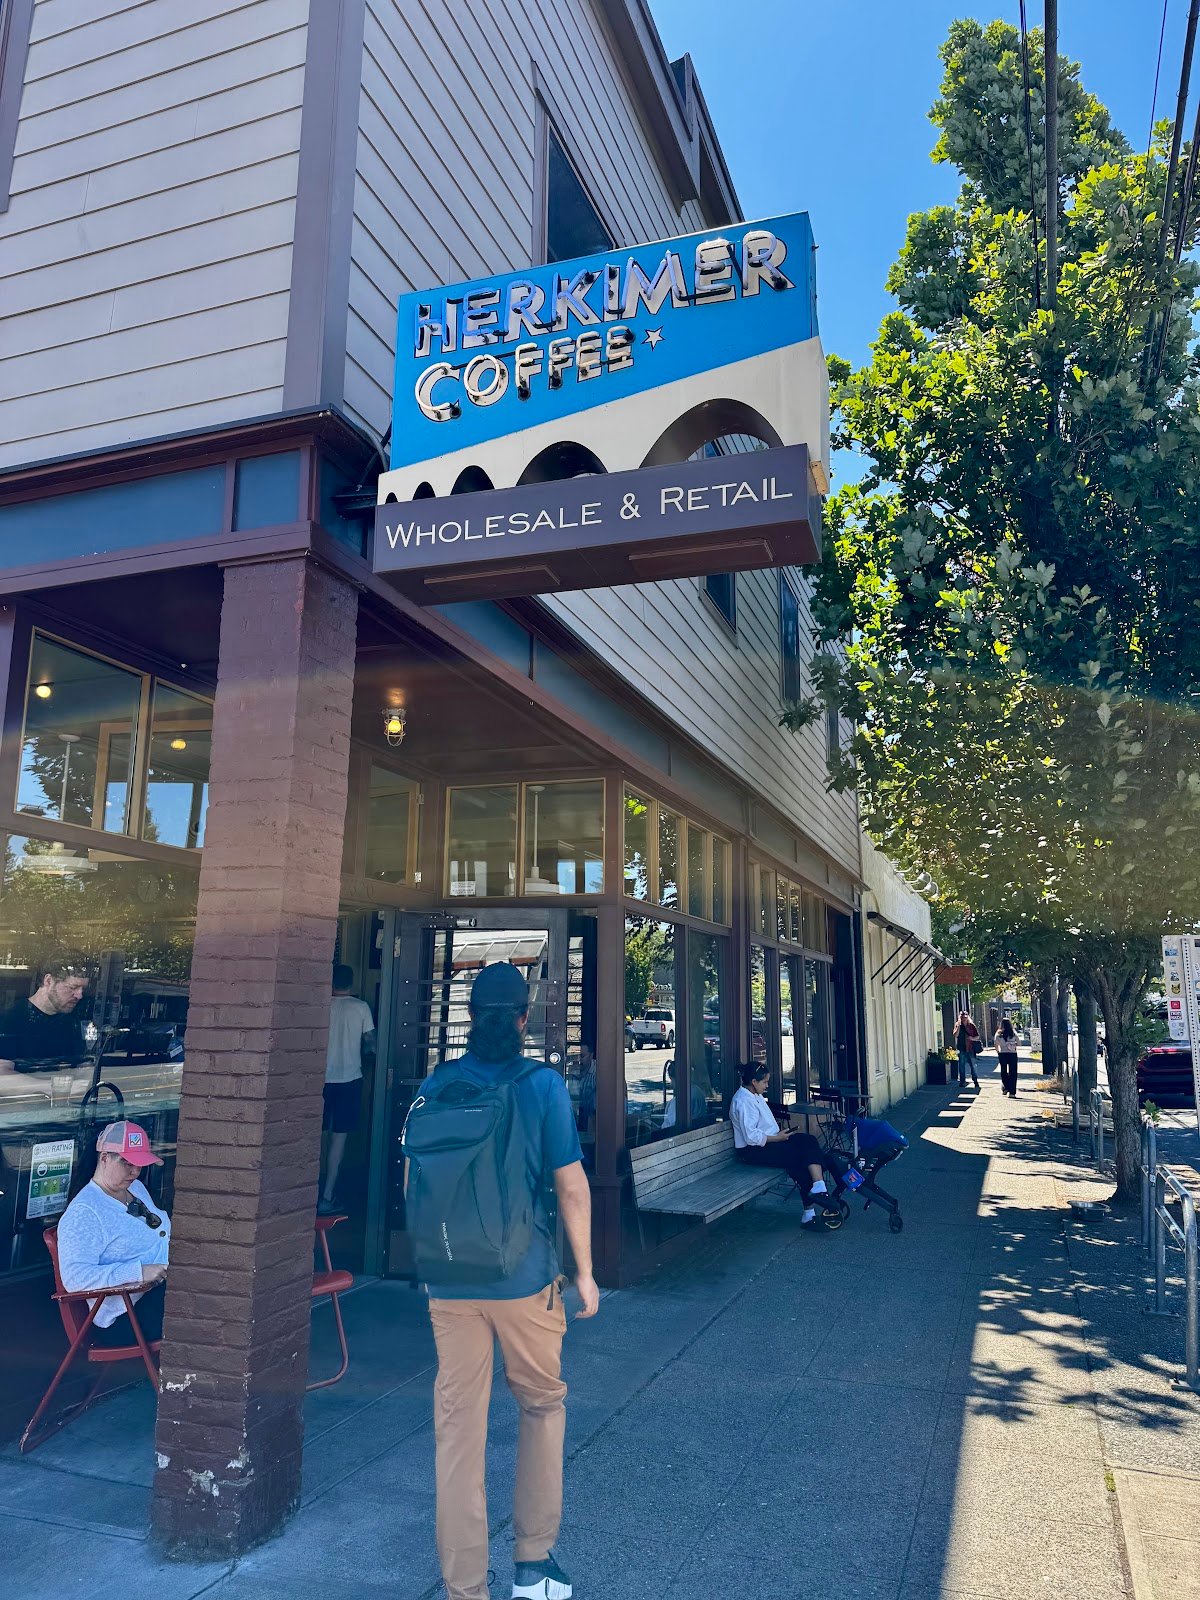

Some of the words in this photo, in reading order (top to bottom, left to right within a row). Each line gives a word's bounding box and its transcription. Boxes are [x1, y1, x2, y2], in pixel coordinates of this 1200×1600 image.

[414, 230, 795, 358] HERKIMER
[414, 326, 634, 423] COFFEE
[620, 494, 641, 520] &
[51, 1142, 73, 1153] RATING
